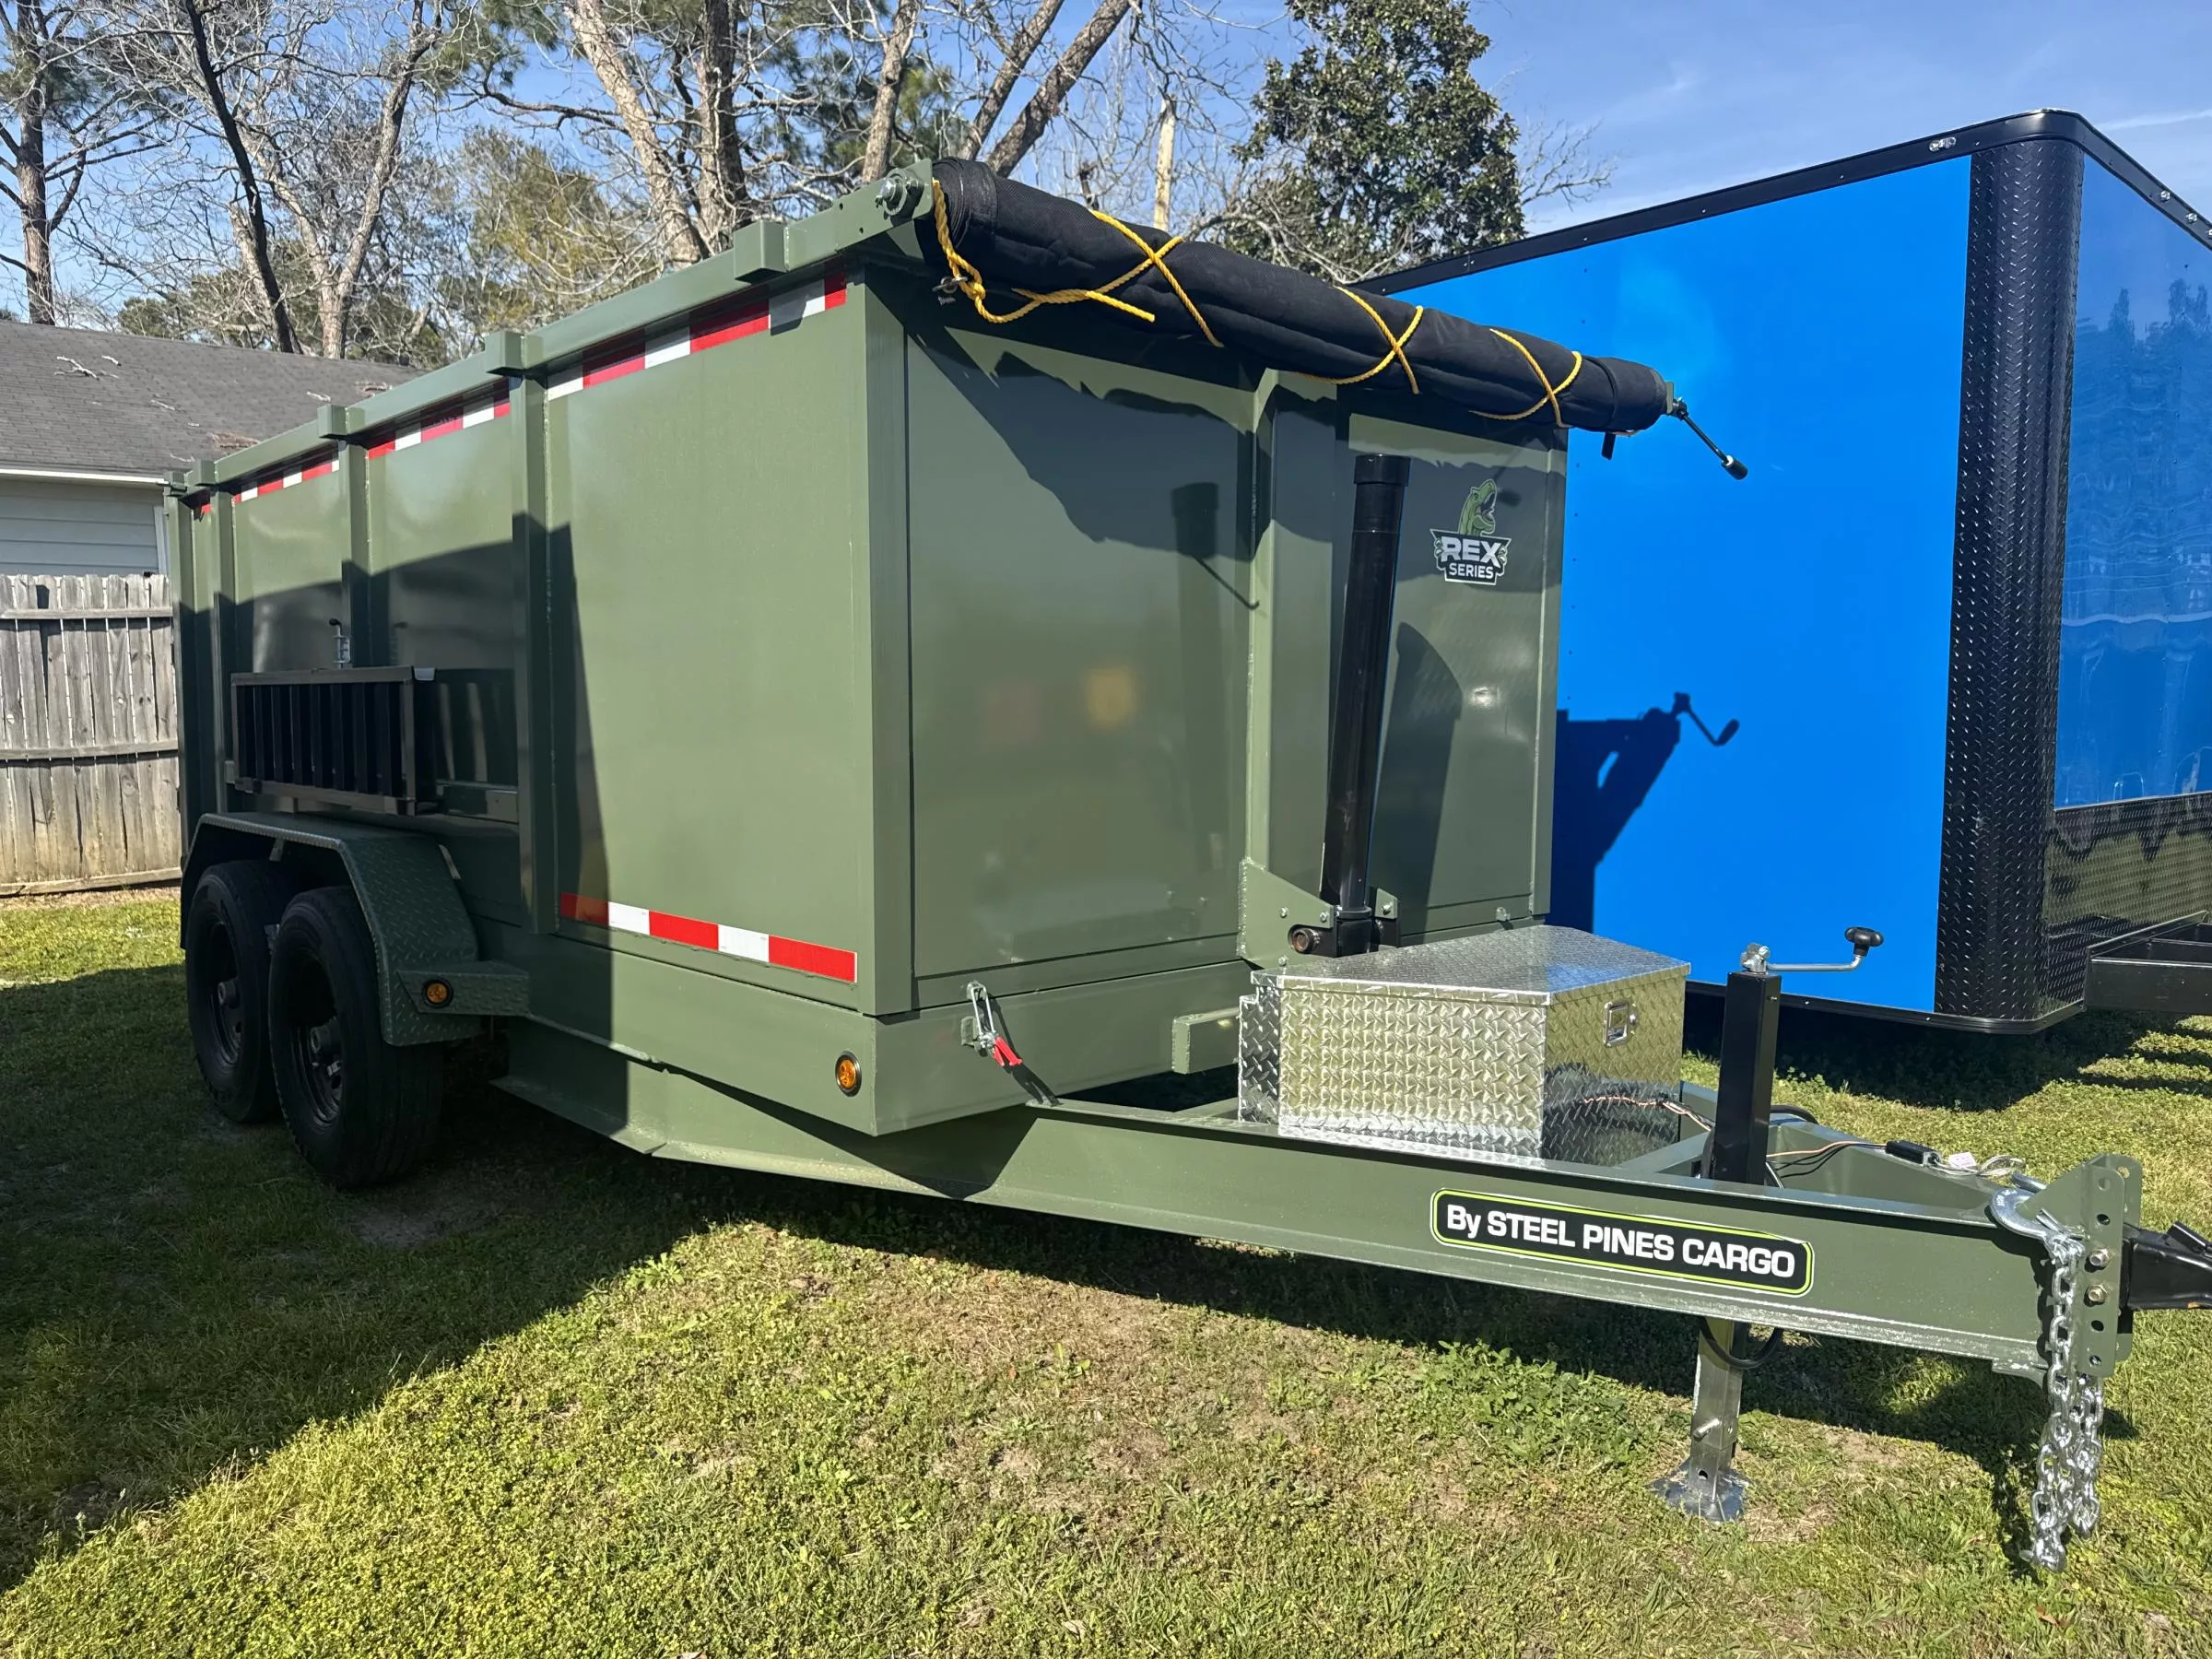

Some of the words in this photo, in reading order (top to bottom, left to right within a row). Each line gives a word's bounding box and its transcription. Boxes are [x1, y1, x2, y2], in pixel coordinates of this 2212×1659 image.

[1441, 536, 1501, 568] REX
[1449, 563, 1494, 579] SERIES
[1447, 1204, 1481, 1239] By
[1487, 1210, 1575, 1247] STEEL
[1583, 1224, 1674, 1261] PINES
[1682, 1239, 1795, 1278] CARGO
